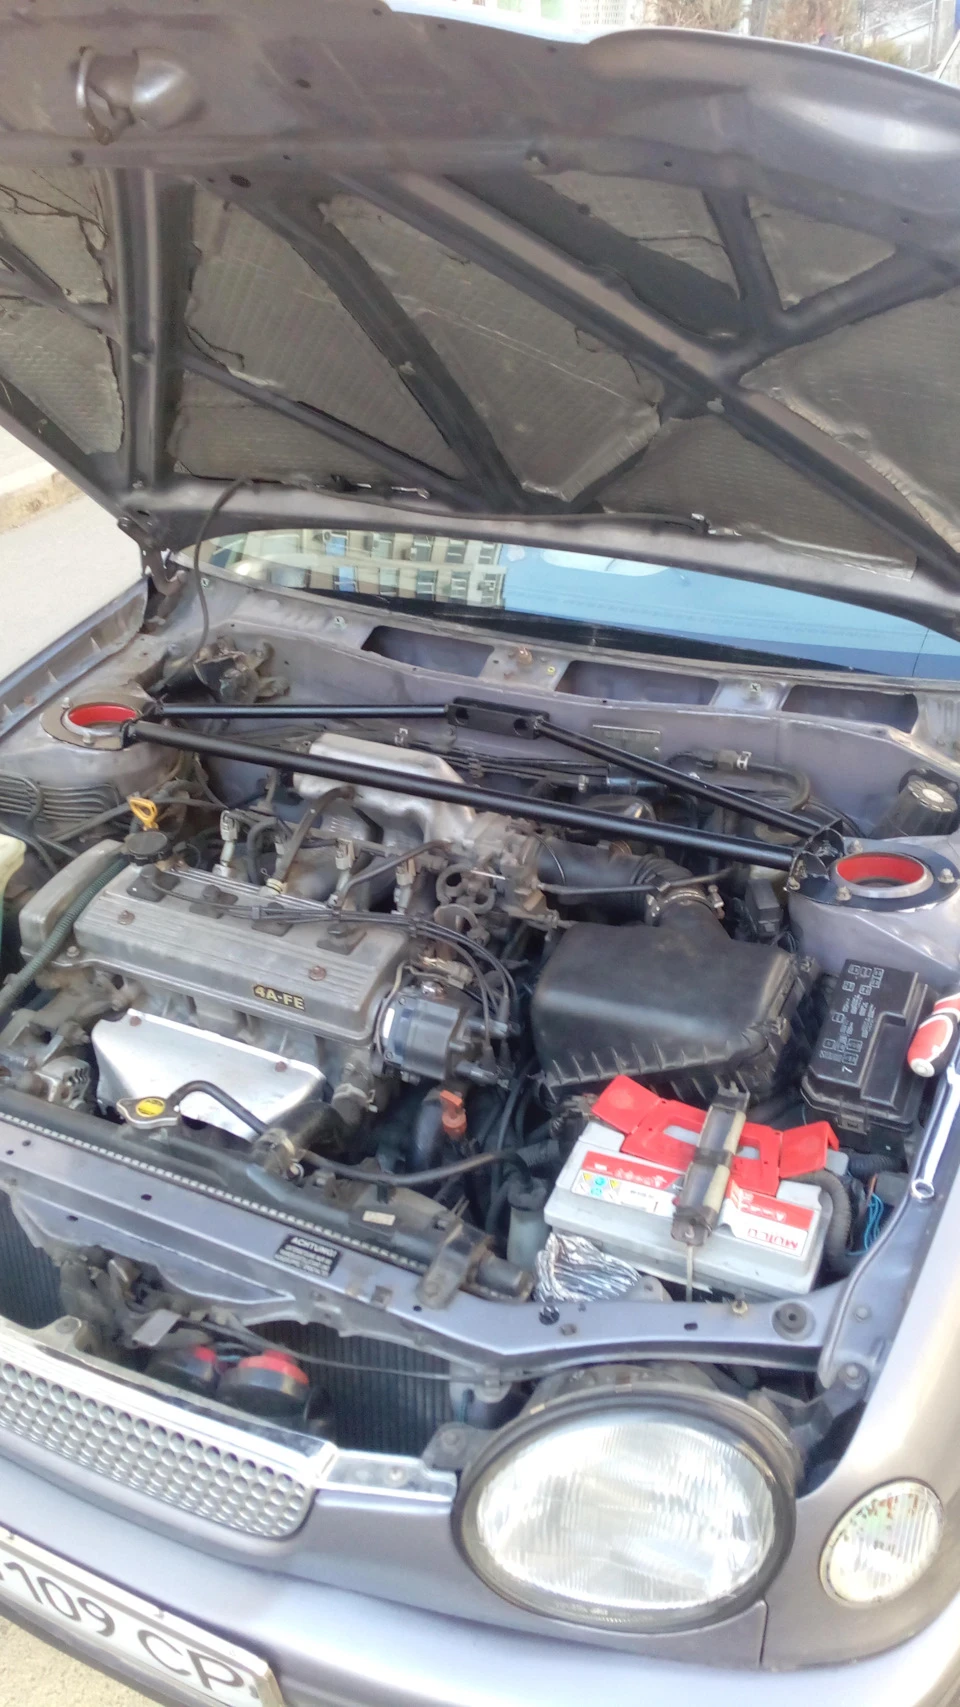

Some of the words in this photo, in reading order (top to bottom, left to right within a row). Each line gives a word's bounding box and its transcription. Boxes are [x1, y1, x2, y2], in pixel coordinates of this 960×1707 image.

[254, 985, 305, 1010] 4A-FE
[0, 1561, 116, 1637] 109
[136, 1629, 245, 1690] CP
